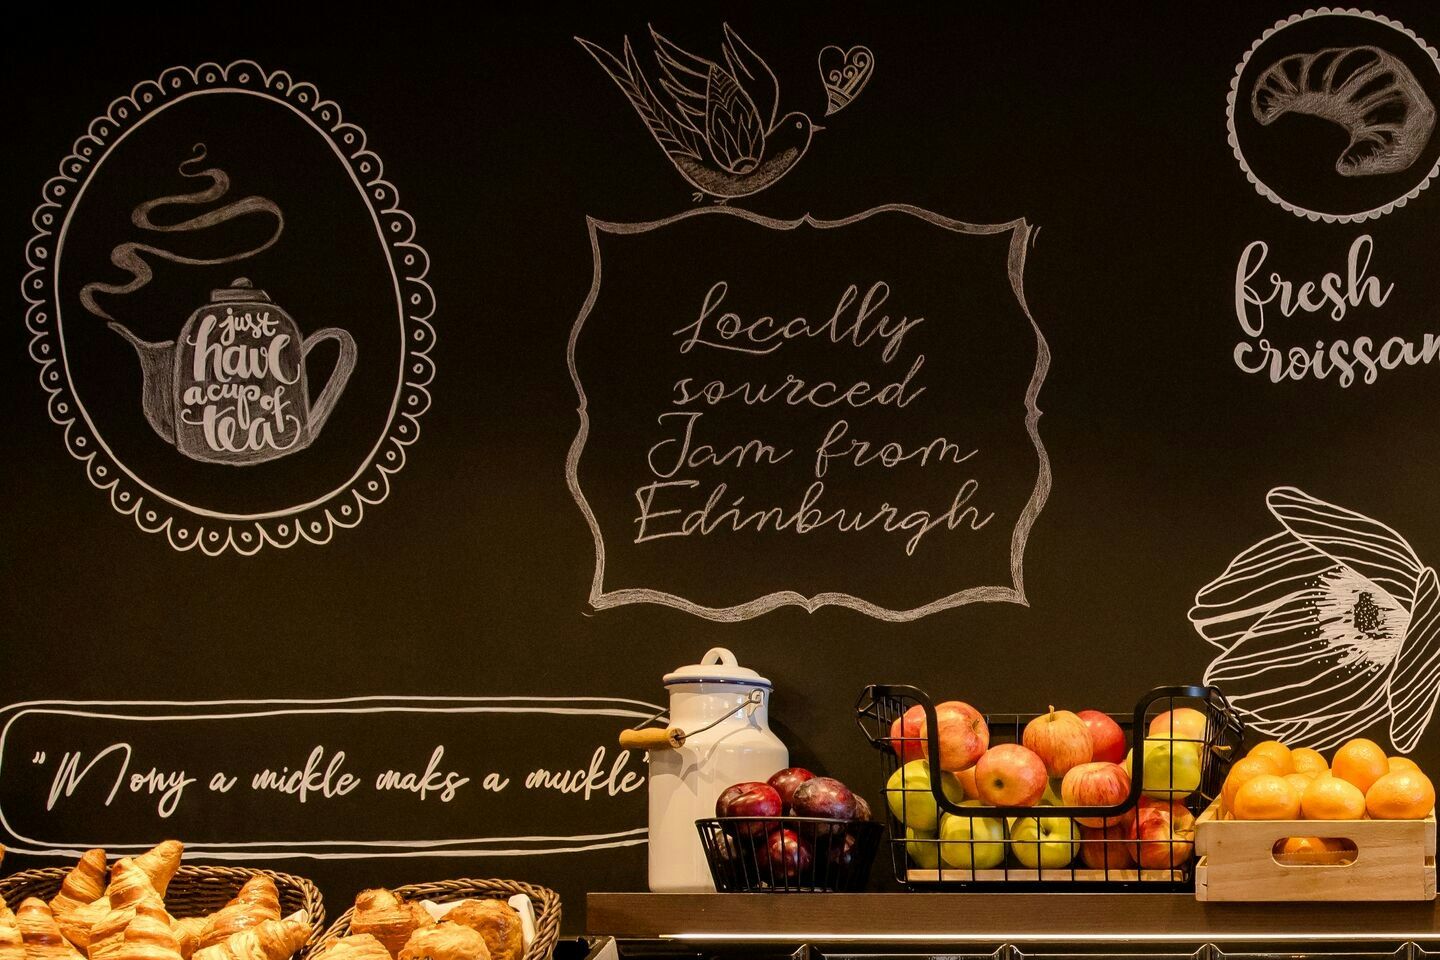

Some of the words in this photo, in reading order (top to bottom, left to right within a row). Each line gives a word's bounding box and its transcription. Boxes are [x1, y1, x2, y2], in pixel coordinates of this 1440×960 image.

[1235, 234, 1394, 337] fresh
[186, 314, 300, 385] have
[219, 307, 279, 346] just
[673, 281, 923, 361] Locally
[184, 386, 207, 405] a
[207, 384, 261, 430] cup
[260, 385, 291, 433] of
[673, 354, 926, 408] sourced
[181, 405, 300, 452] tea
[647, 412, 794, 478] Jam
[815, 419, 978, 477] from
[634, 479, 995, 556] Edinburgh
[208, 768, 237, 793] a
[252, 745, 361, 803] mickle
[376, 745, 469, 803] maks
[483, 772, 510, 793] a
